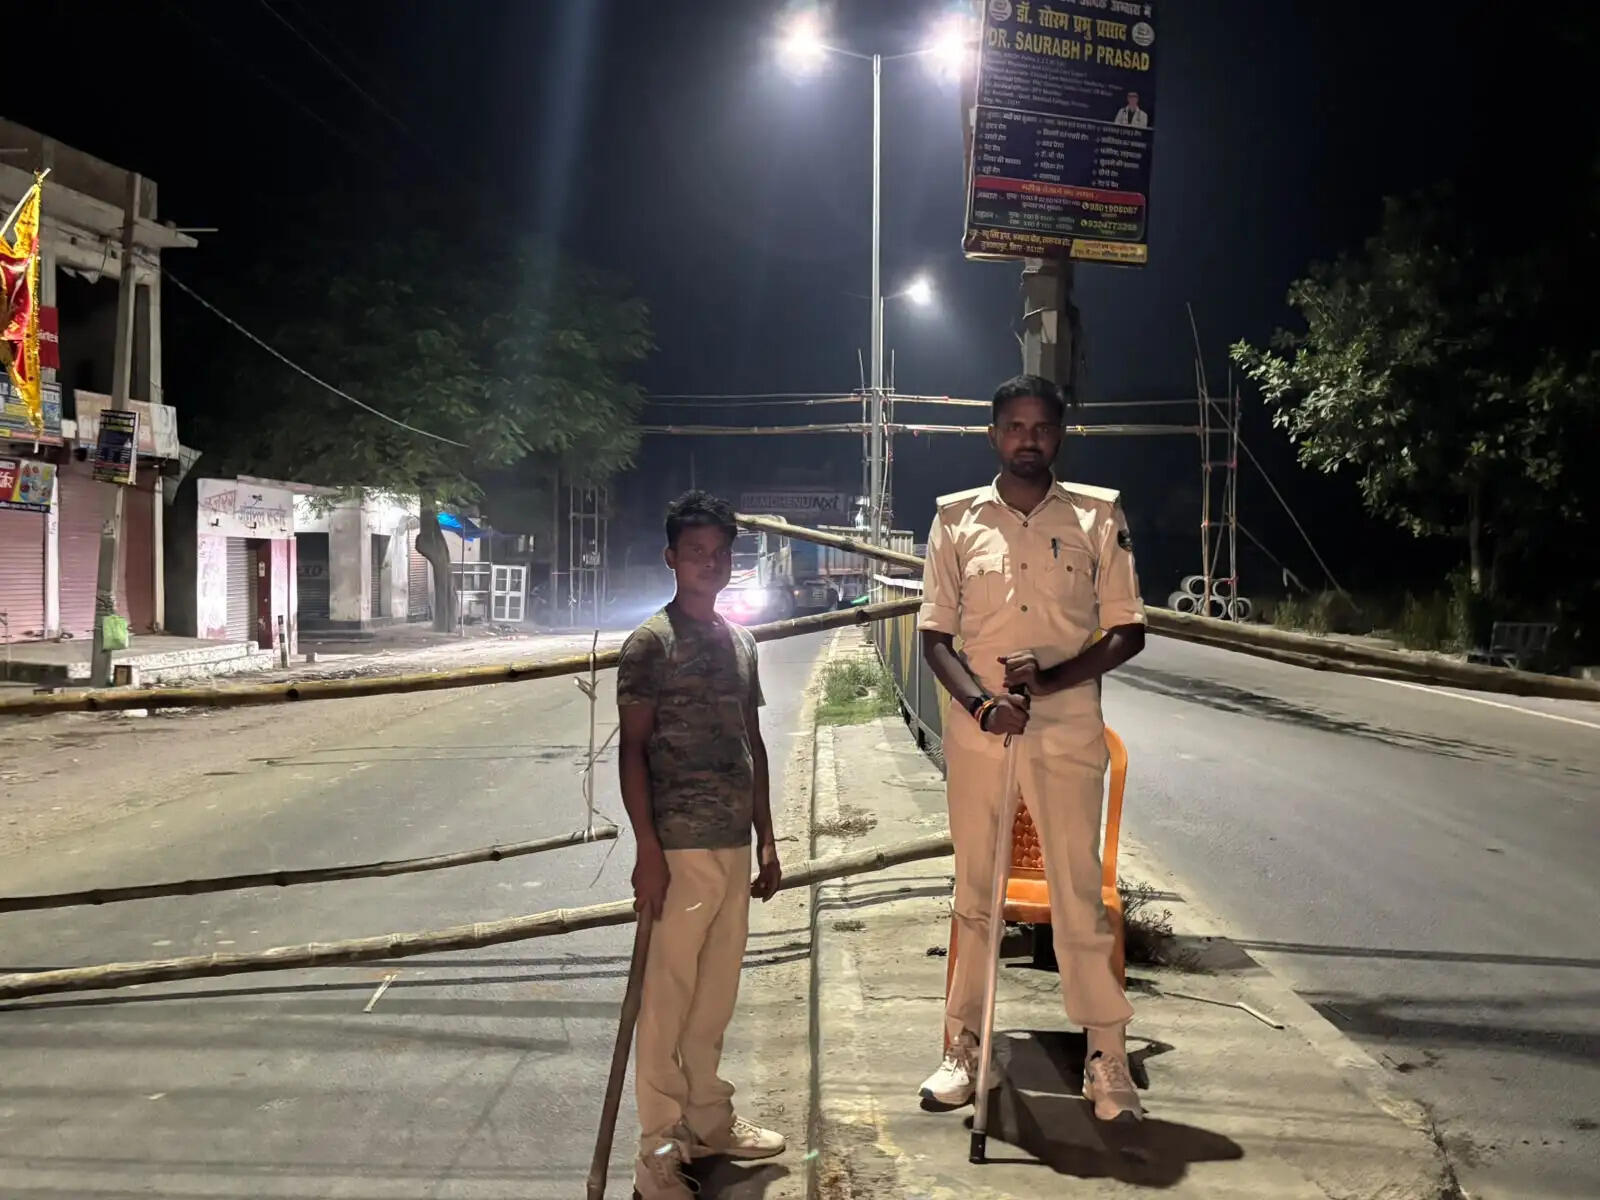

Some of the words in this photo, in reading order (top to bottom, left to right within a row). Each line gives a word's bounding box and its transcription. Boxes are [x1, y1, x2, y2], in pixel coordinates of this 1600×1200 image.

[1016, 1, 1033, 24] डॉ.
[987, 27, 1011, 49] DR.
[1015, 31, 1081, 60] SAURABH
[1084, 42, 1093, 62] P
[1096, 45, 1150, 71] PRASAD
